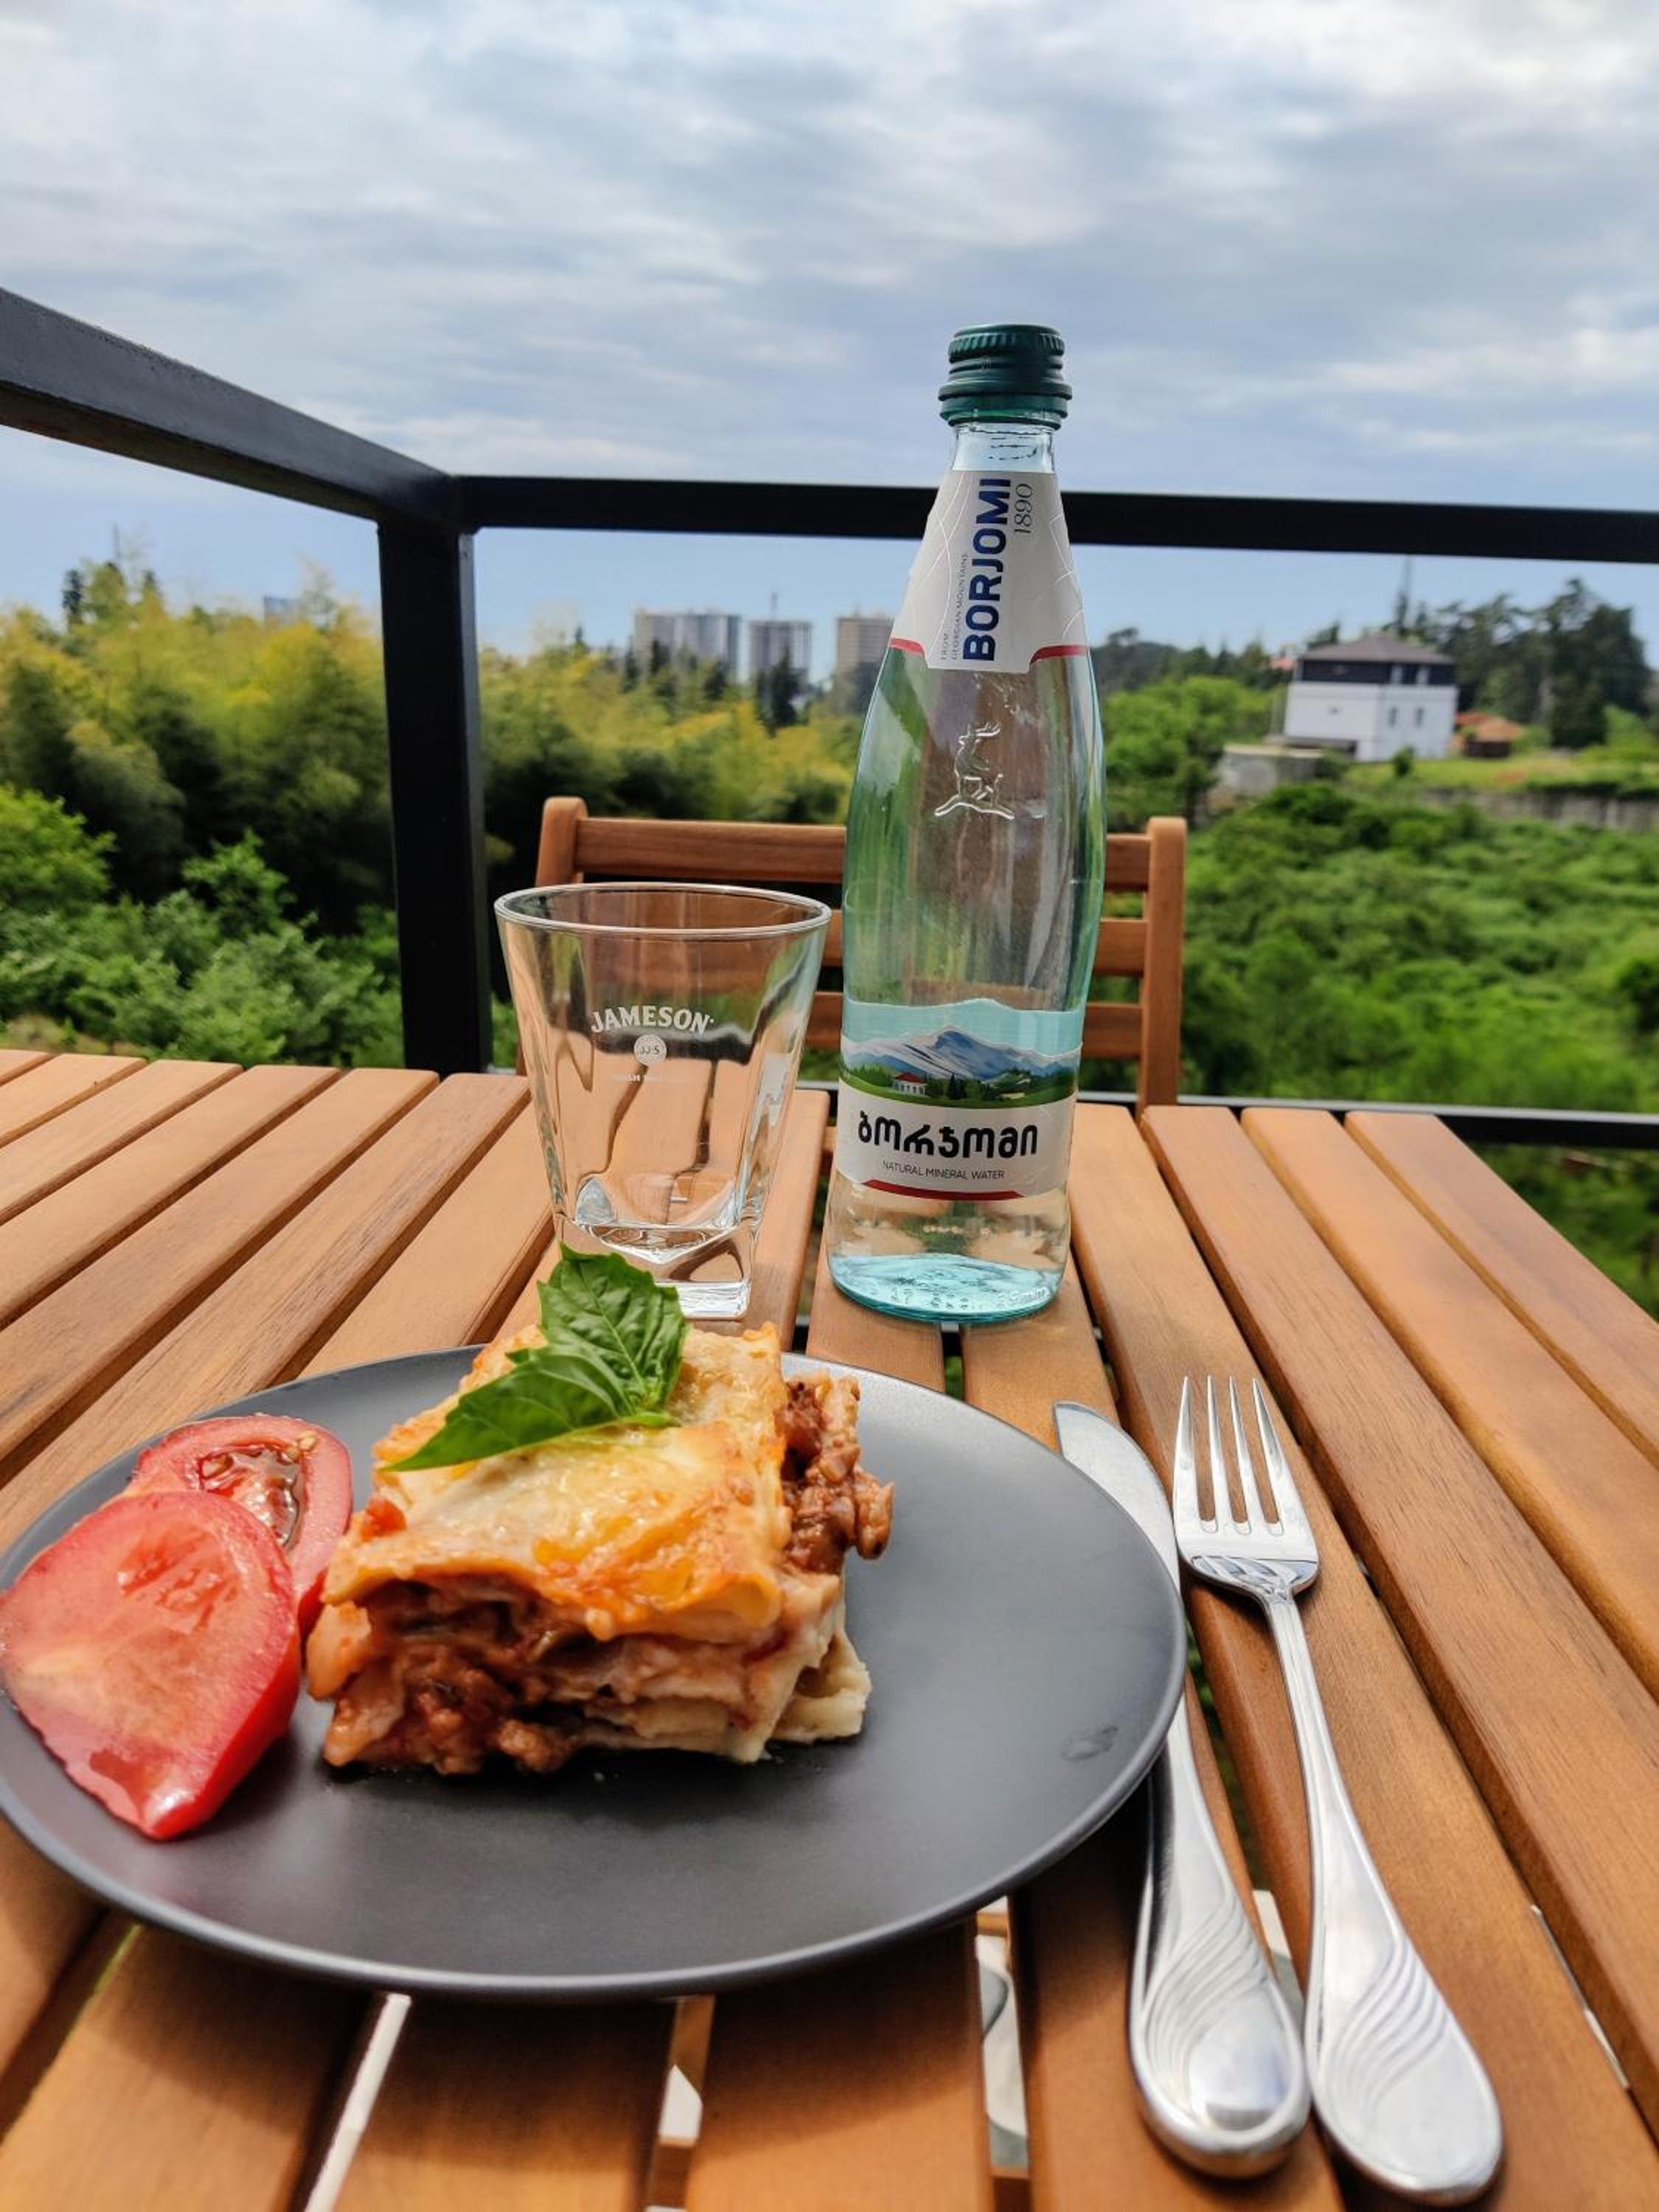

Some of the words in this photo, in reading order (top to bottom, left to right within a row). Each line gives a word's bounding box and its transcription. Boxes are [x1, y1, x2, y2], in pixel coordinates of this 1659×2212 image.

[1014, 483, 1033, 534] 1890
[956, 554, 968, 609] MOUNTAINS
[963, 479, 1011, 661] BORJOMI
[591, 1005, 710, 1034] JAMESON
[858, 1110, 1038, 1158] ბორჯომი
[883, 1160, 923, 1176] NATURAL
[925, 1169, 967, 1180] MINERAL
[970, 1169, 1005, 1180] WATER
